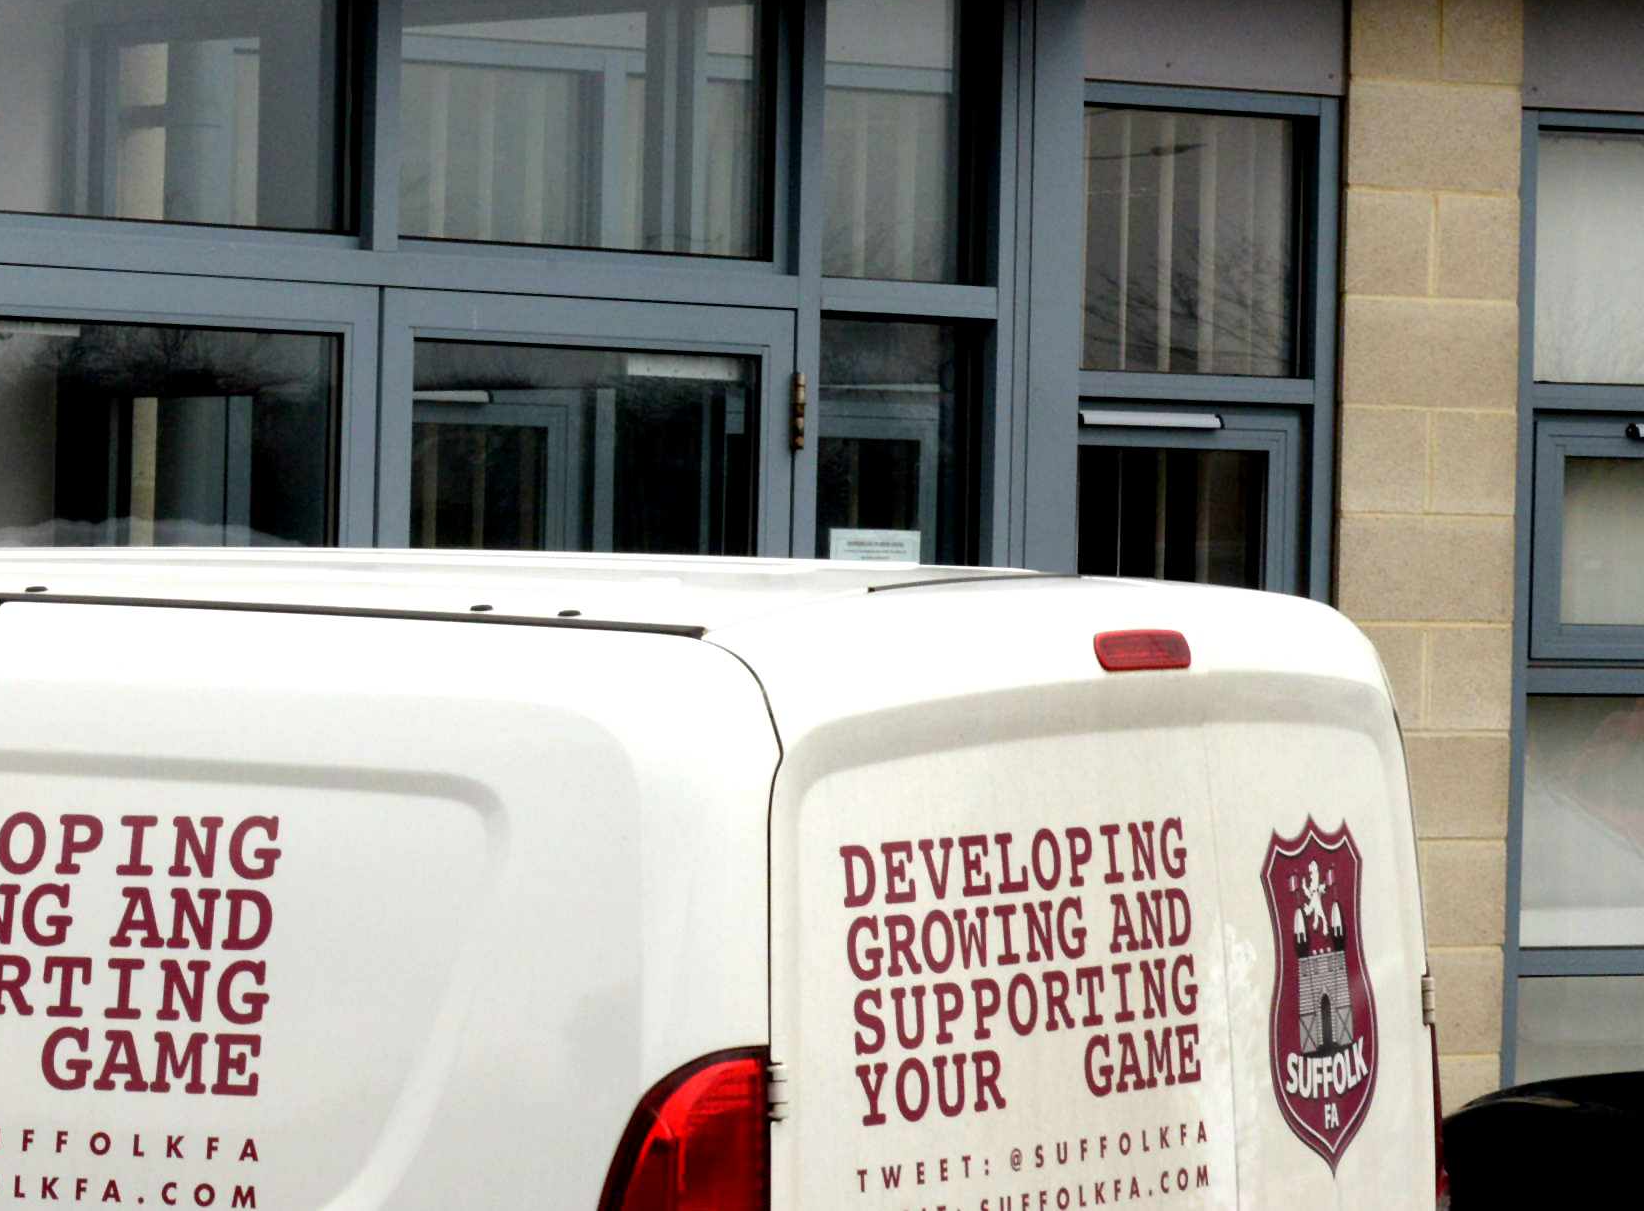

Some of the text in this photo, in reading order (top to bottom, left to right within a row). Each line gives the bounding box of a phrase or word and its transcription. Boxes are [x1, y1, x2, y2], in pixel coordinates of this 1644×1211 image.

[839, 817, 1188, 908] DEVELOPING
[109, 886, 274, 951] AND
[847, 887, 1192, 982] GROWING AND
[854, 953, 1201, 1055] SUPPORTING
[41, 1026, 262, 1097] GAME
[855, 1023, 1203, 1127] YOUR GAME
[1285, 1035, 1369, 1099] SUFFOLK
[1324, 1102, 1341, 1130] FA
[856, 1120, 1208, 1192] TWEET: @SUFFOLKFA
